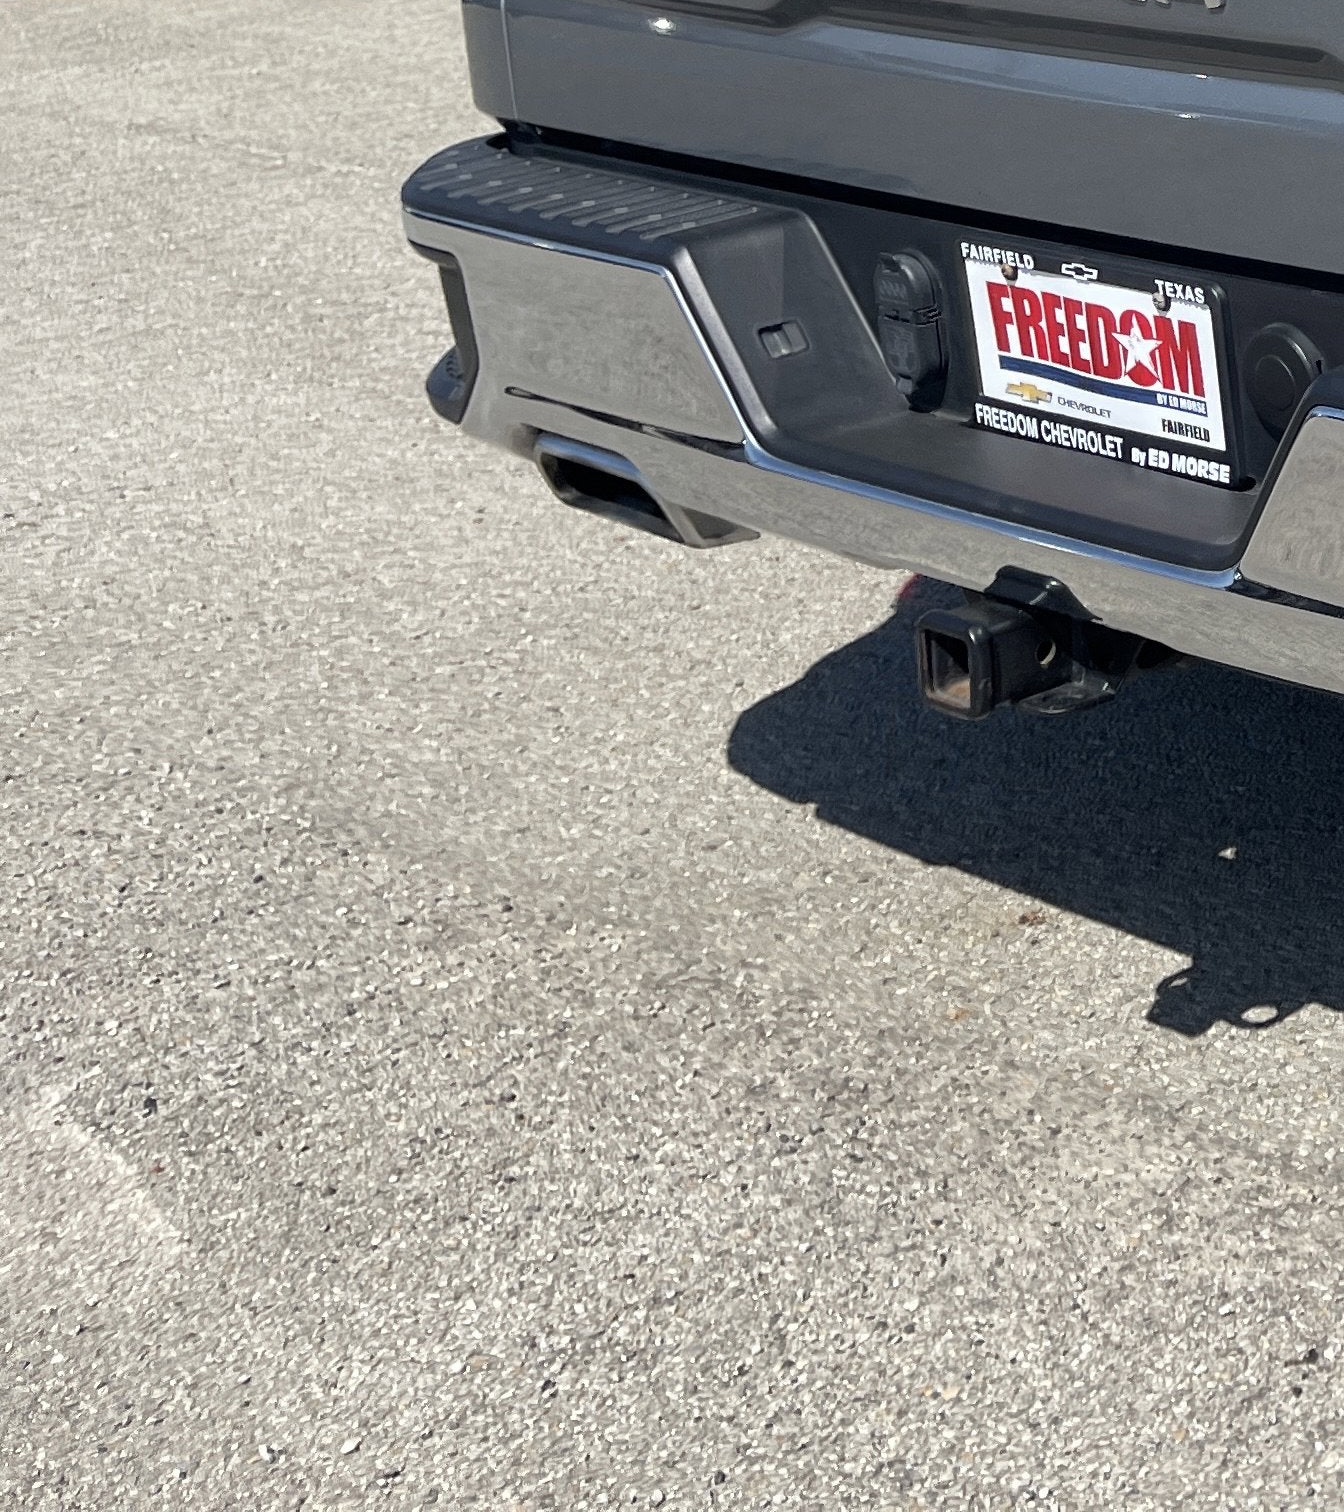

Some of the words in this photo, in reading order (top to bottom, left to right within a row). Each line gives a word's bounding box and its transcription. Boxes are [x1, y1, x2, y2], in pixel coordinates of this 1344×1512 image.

[961, 242, 1034, 270] FAIRFIELD
[1154, 279, 1205, 304] TEXAS
[986, 281, 1205, 398] FREEDOM
[1057, 396, 1112, 419] CHEVROLET
[975, 402, 1039, 440] FREEDOM
[1040, 419, 1124, 459] CHEVROLET
[1148, 447, 1170, 469] ED
[1171, 453, 1231, 484] MORSE
[1161, 418, 1210, 443] FAIRFIELD
